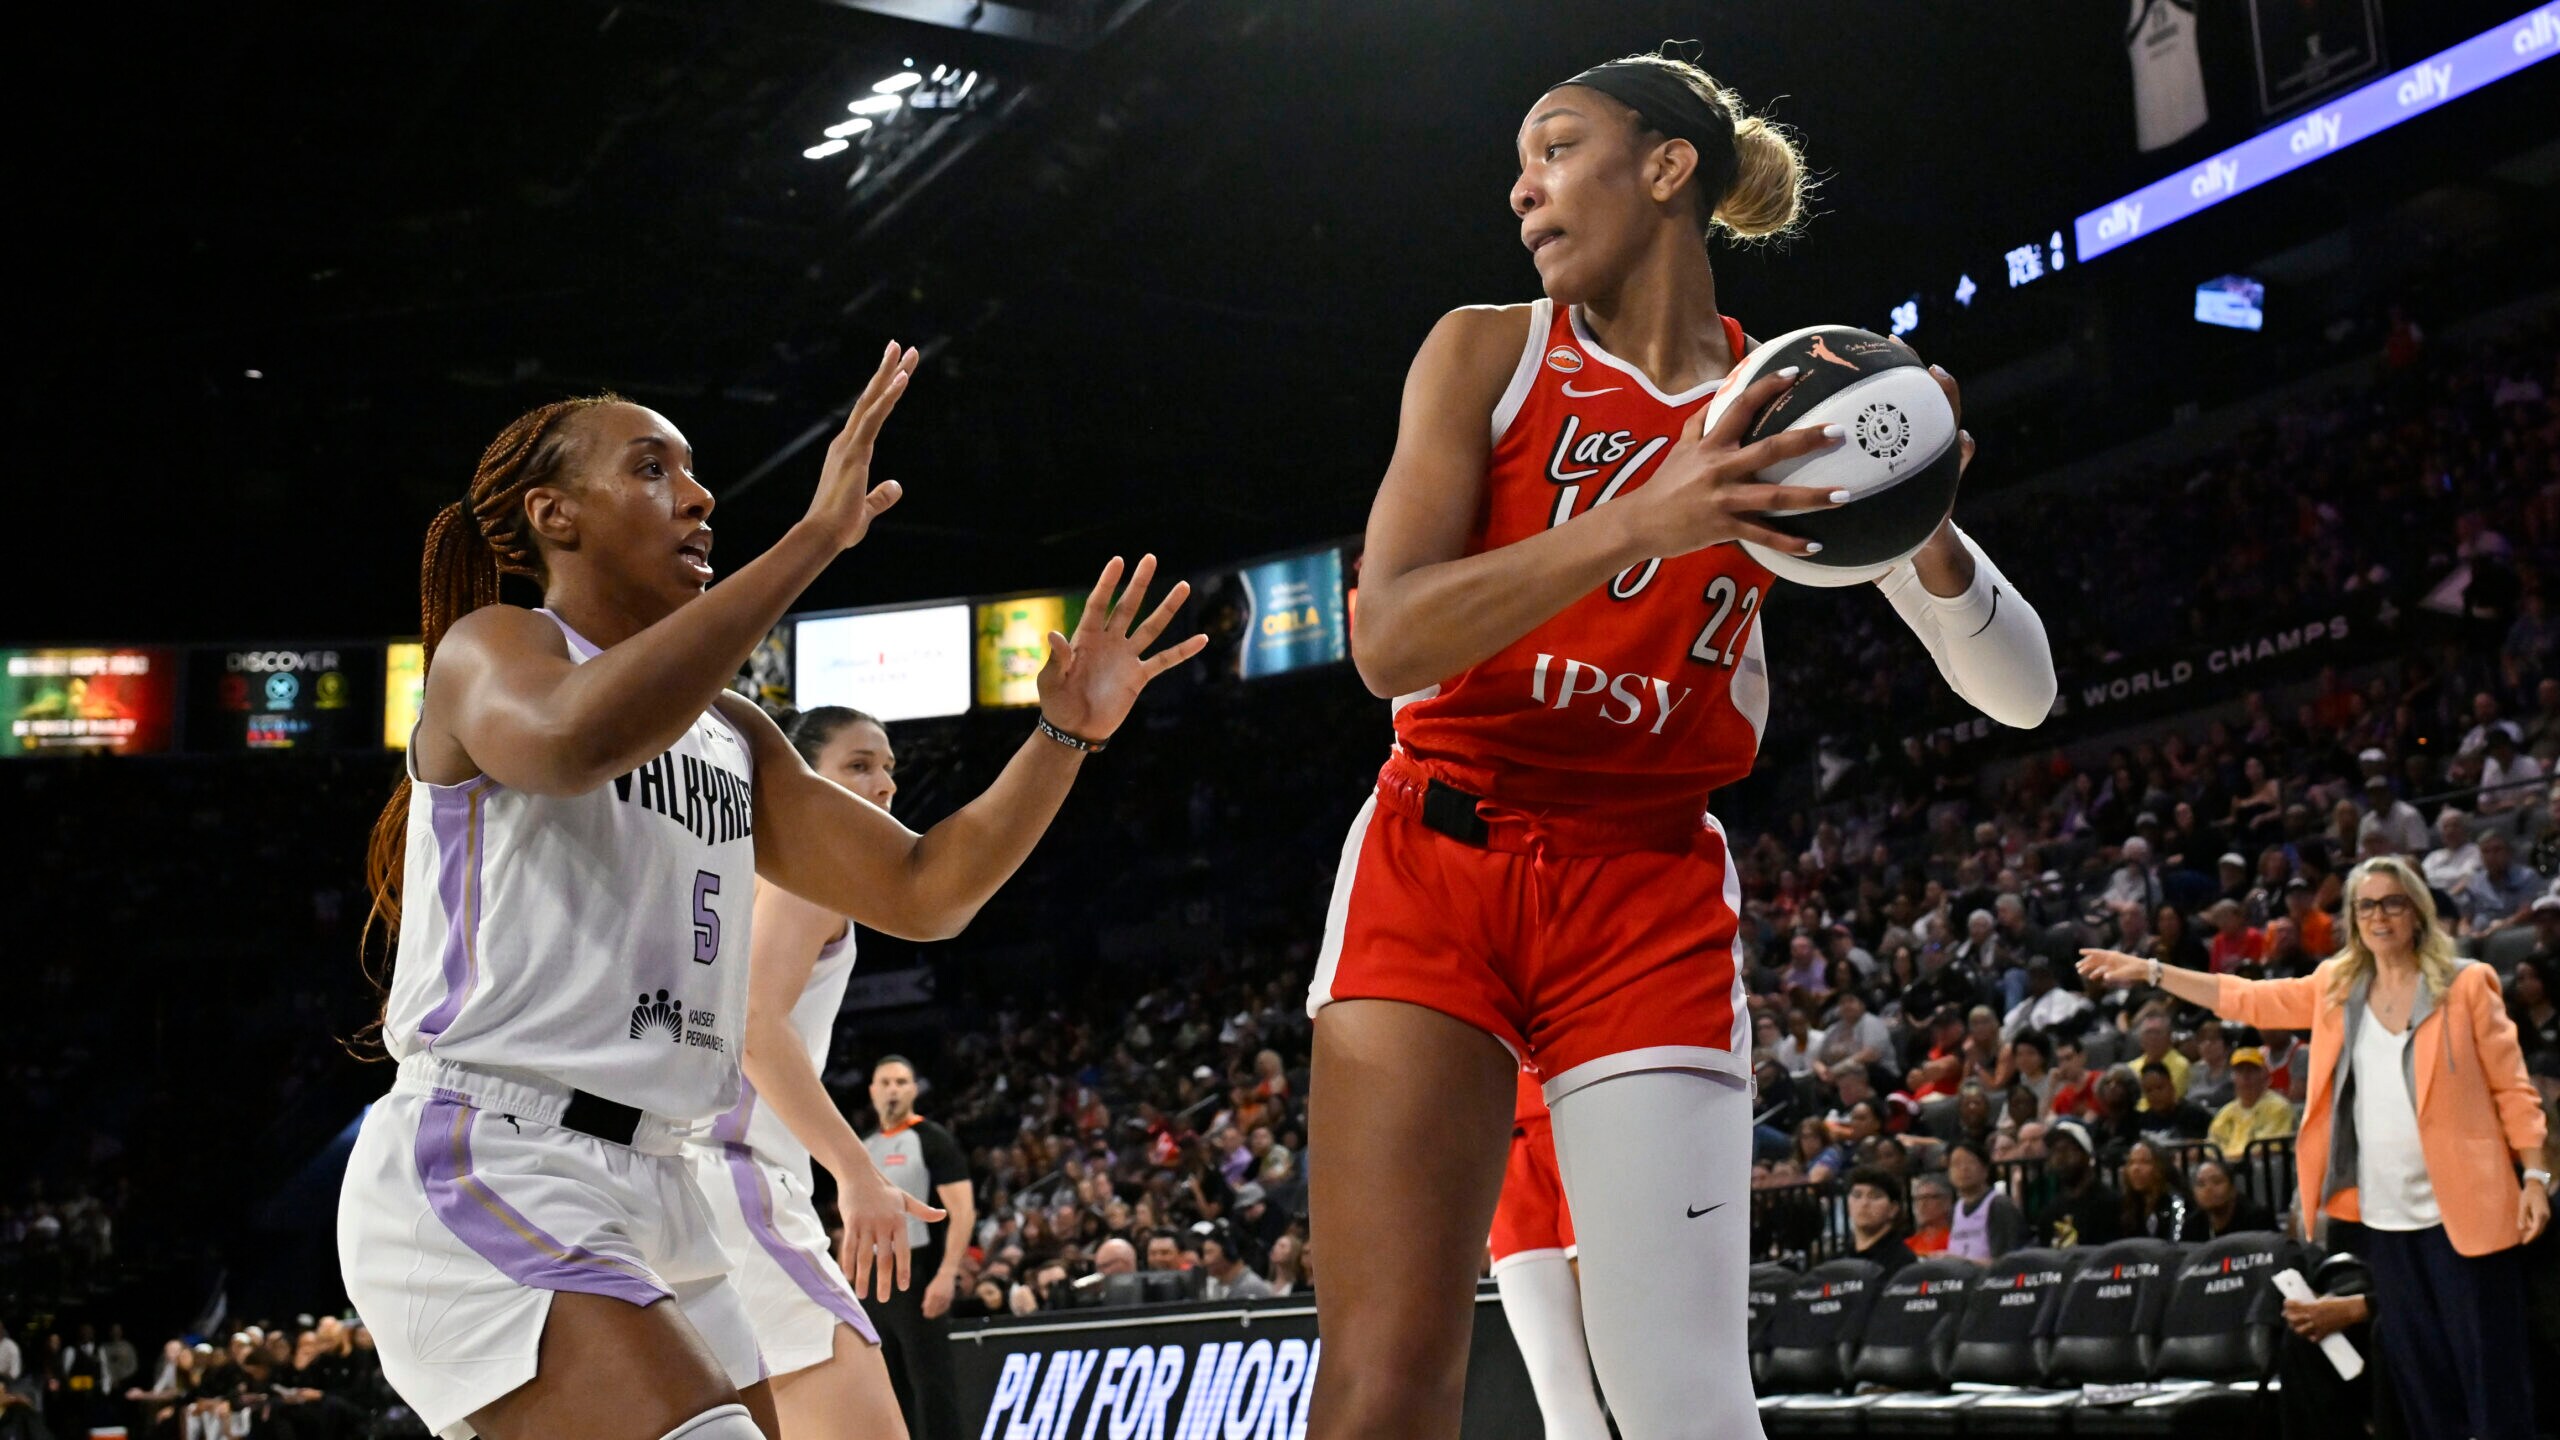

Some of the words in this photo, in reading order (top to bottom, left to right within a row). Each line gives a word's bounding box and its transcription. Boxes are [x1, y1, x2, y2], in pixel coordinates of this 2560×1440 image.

[2397, 63, 2453, 105] ally
[2290, 112, 2342, 155] ally
[2191, 159, 2239, 199] ally
[2098, 202, 2143, 240] ally
[1547, 414, 1637, 483] Las
[1690, 575, 1760, 670] 22
[1531, 653, 1692, 735] IPSY
[2083, 660, 2193, 708] WORLD
[2208, 614, 2349, 674] CHAMPS
[614, 750, 752, 846] VALKYRIE
[693, 869, 720, 966] 5
[688, 1009, 715, 1028] KAISER
[980, 1352, 1099, 1440] PLAY
[1082, 1345, 1185, 1440] FOR
